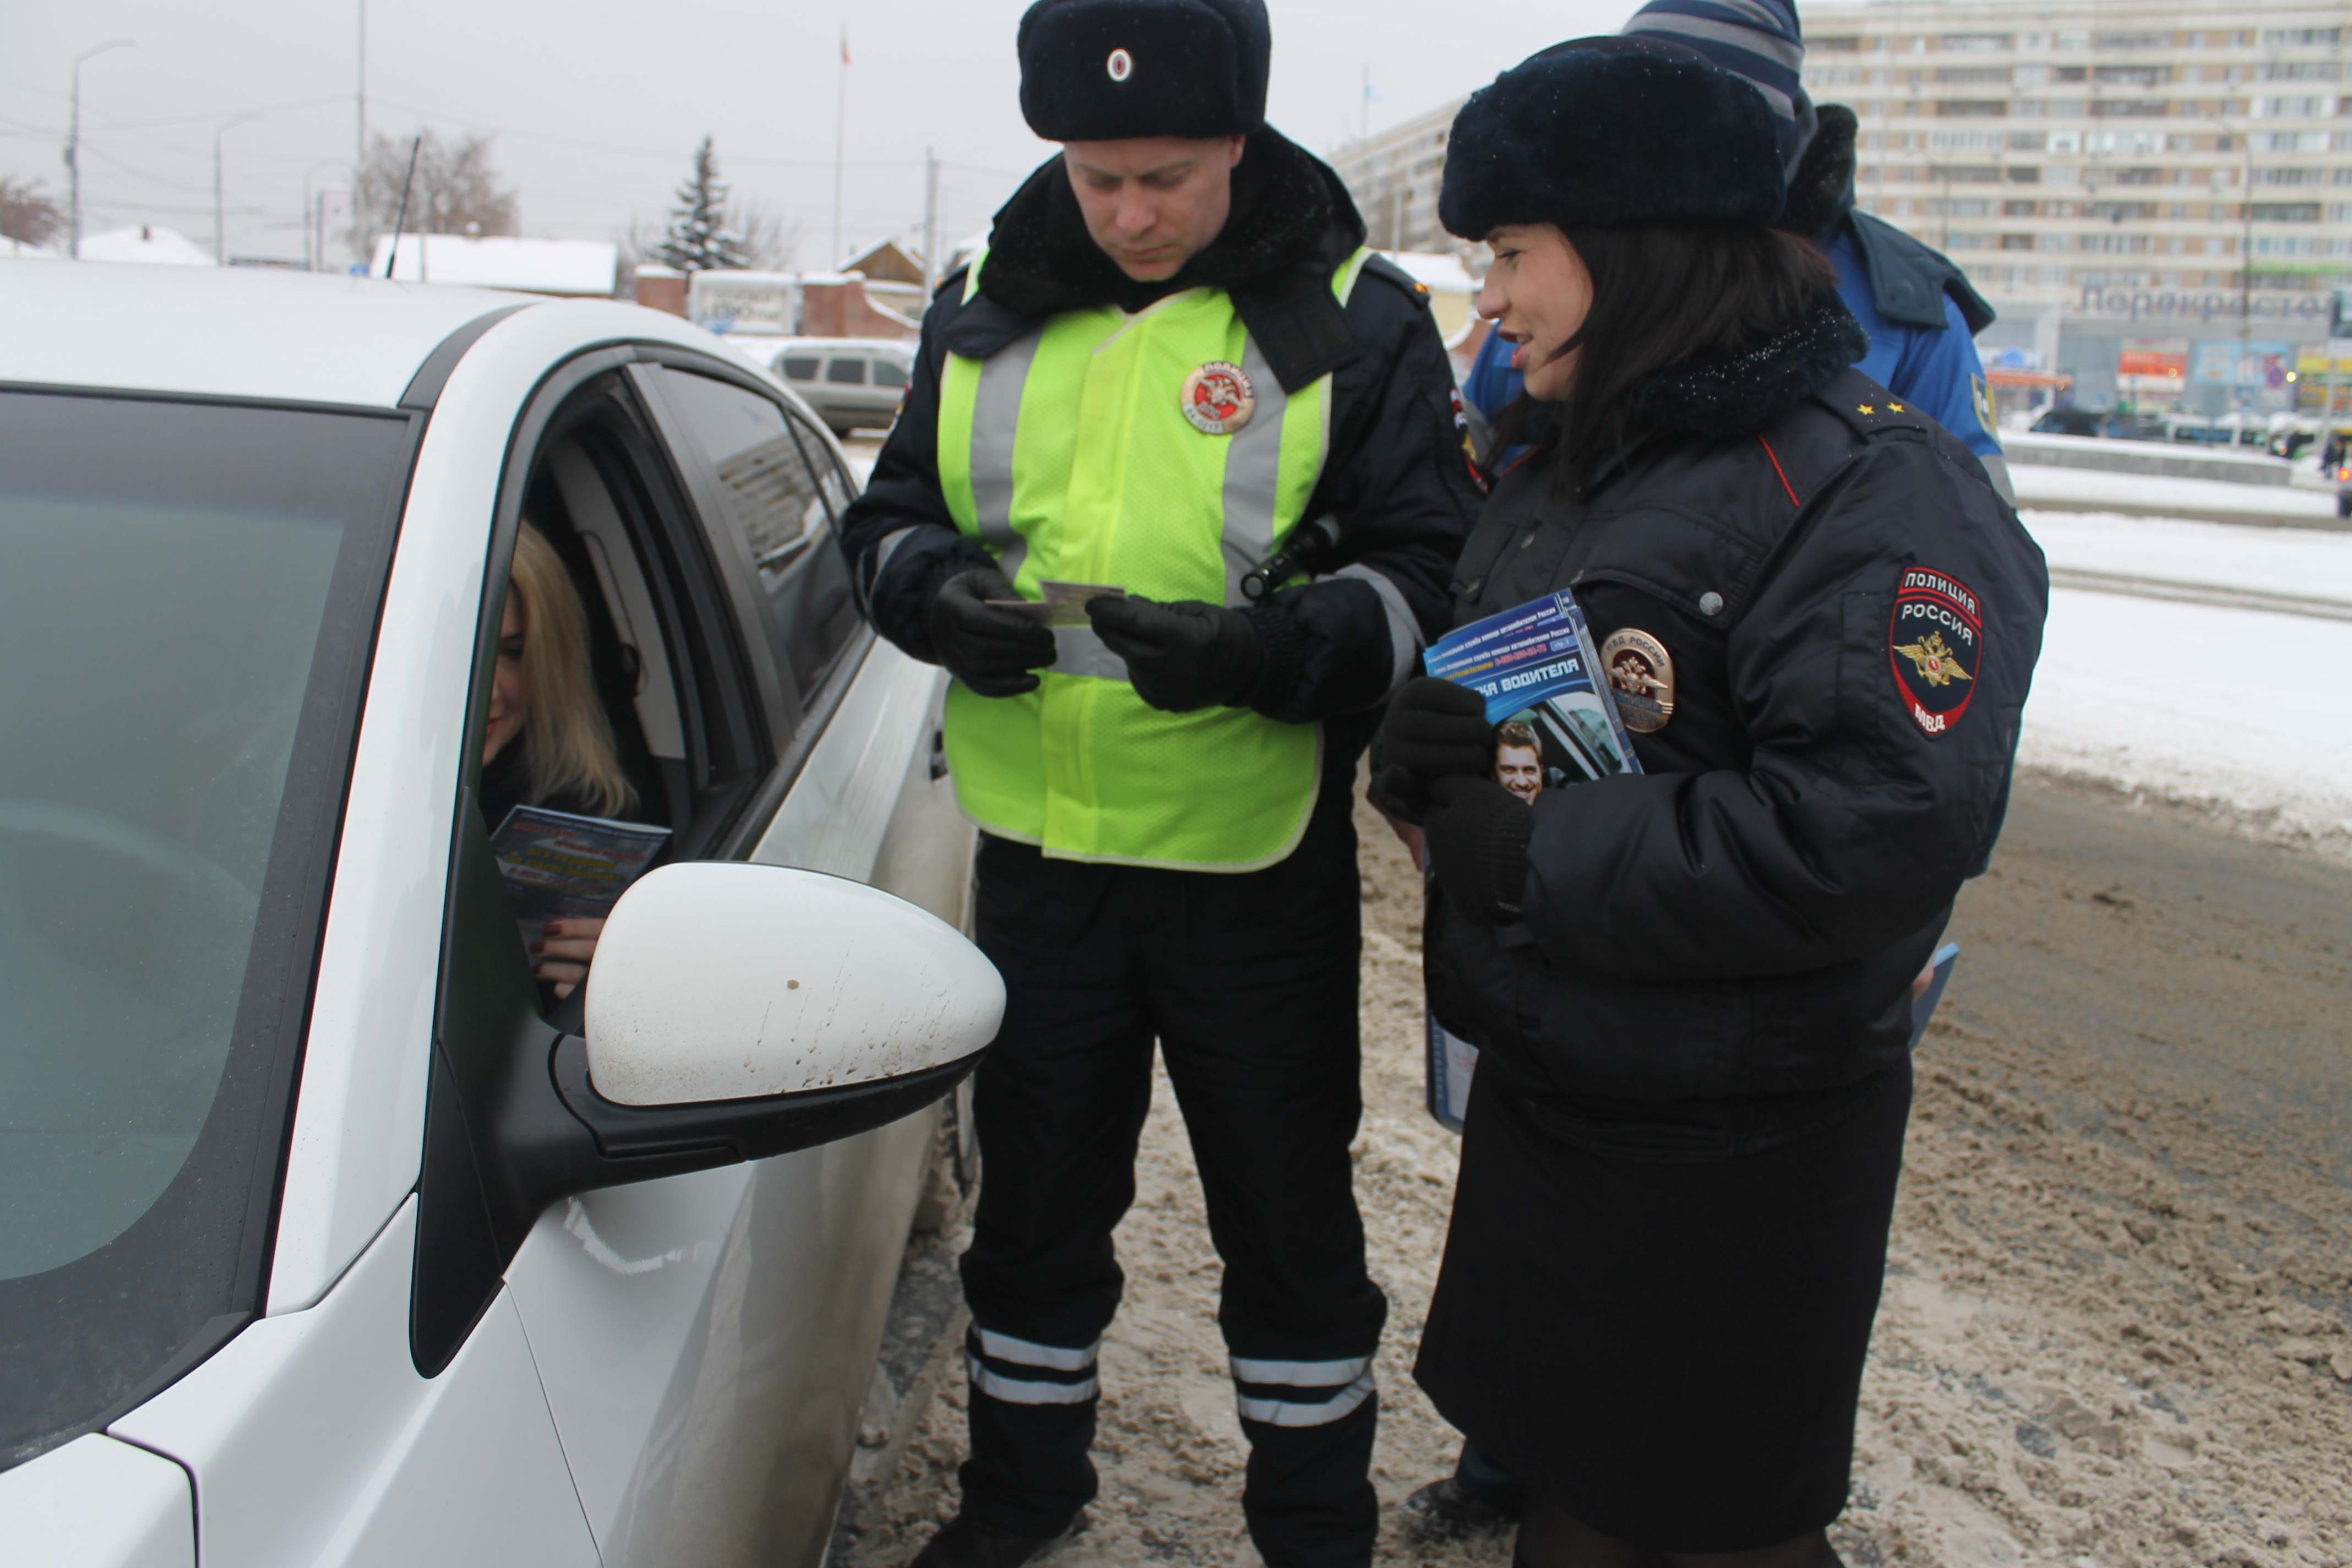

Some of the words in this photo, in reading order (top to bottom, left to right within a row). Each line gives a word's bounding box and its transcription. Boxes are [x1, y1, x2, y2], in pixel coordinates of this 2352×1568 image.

[1904, 573, 1975, 615] ПОЛИЦИЯ
[1901, 604, 1973, 646] РОССИЯ
[1607, 636, 1625, 652] МВД
[1630, 636, 1666, 667] РОССИИ
[1500, 658, 1580, 693] ВОДИТЕЛЯ
[1915, 703, 1946, 732] МВД
